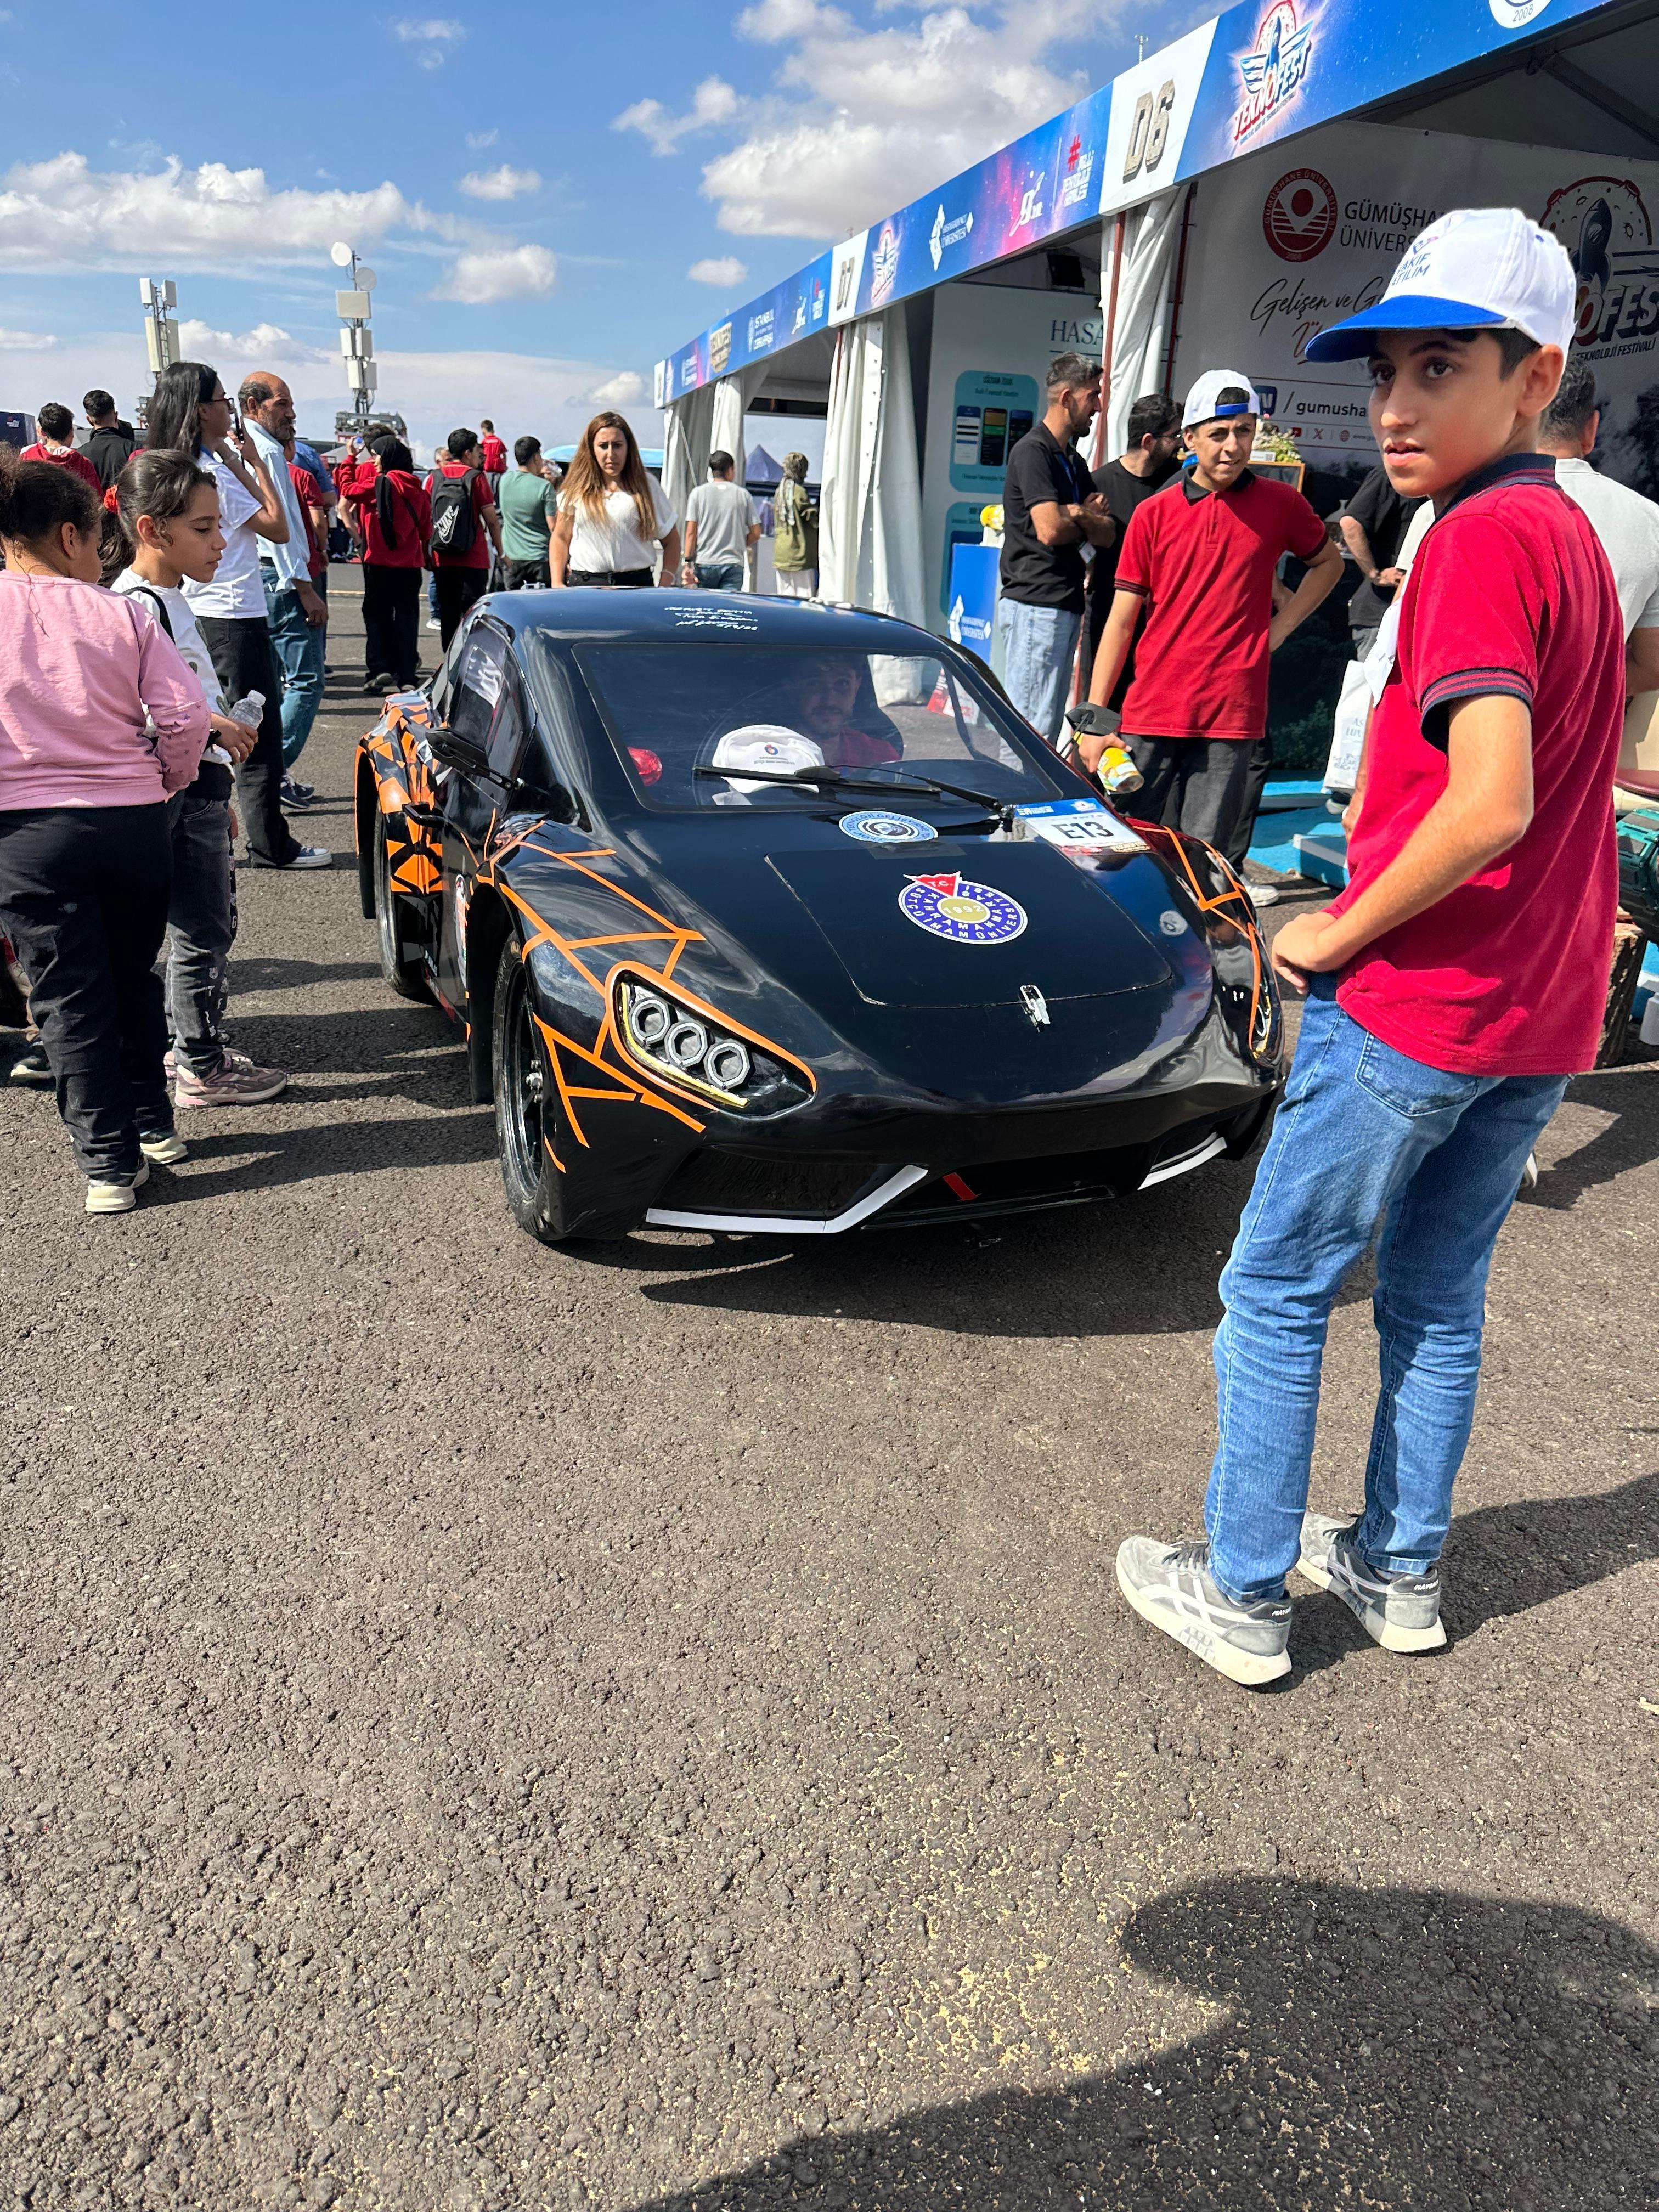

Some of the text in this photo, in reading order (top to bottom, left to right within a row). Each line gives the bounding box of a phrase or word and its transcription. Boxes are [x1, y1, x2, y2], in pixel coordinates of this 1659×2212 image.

[1513, 3, 1533, 22] 2008
[1234, 41, 1312, 141] TEKNOFEST
[1123, 78, 1175, 184] D6
[1345, 199, 1445, 230] GÜMÜŞHA
[1250, 278, 1332, 336] Gelişen
[1335, 293, 1352, 307] ve
[1296, 401, 1369, 417] gumusha
[1052, 821, 1114, 839] E13
[943, 905, 984, 915] 1992
